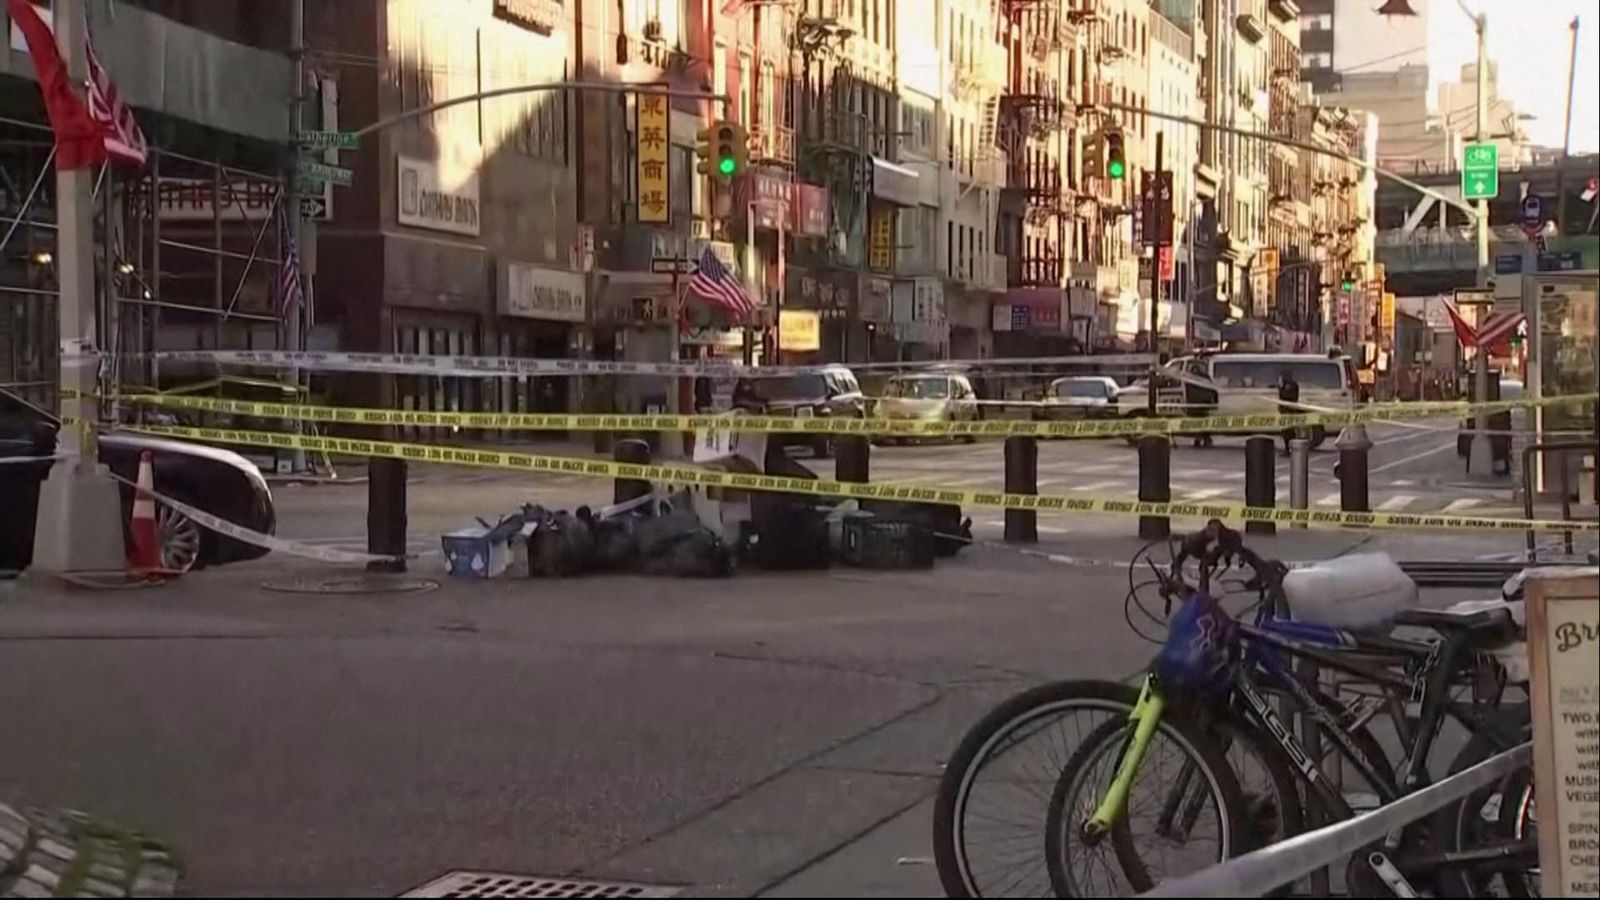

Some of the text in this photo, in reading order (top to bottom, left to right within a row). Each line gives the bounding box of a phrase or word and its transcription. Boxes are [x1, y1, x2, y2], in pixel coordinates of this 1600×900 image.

[1103, 501, 1230, 518] CRIME SCENE DO NOT CROSS
[1241, 509, 1375, 525] CRIME SCENE DO NOT CROSS
[1562, 712, 1592, 723] TWO
[1568, 840, 1599, 851] BRO
